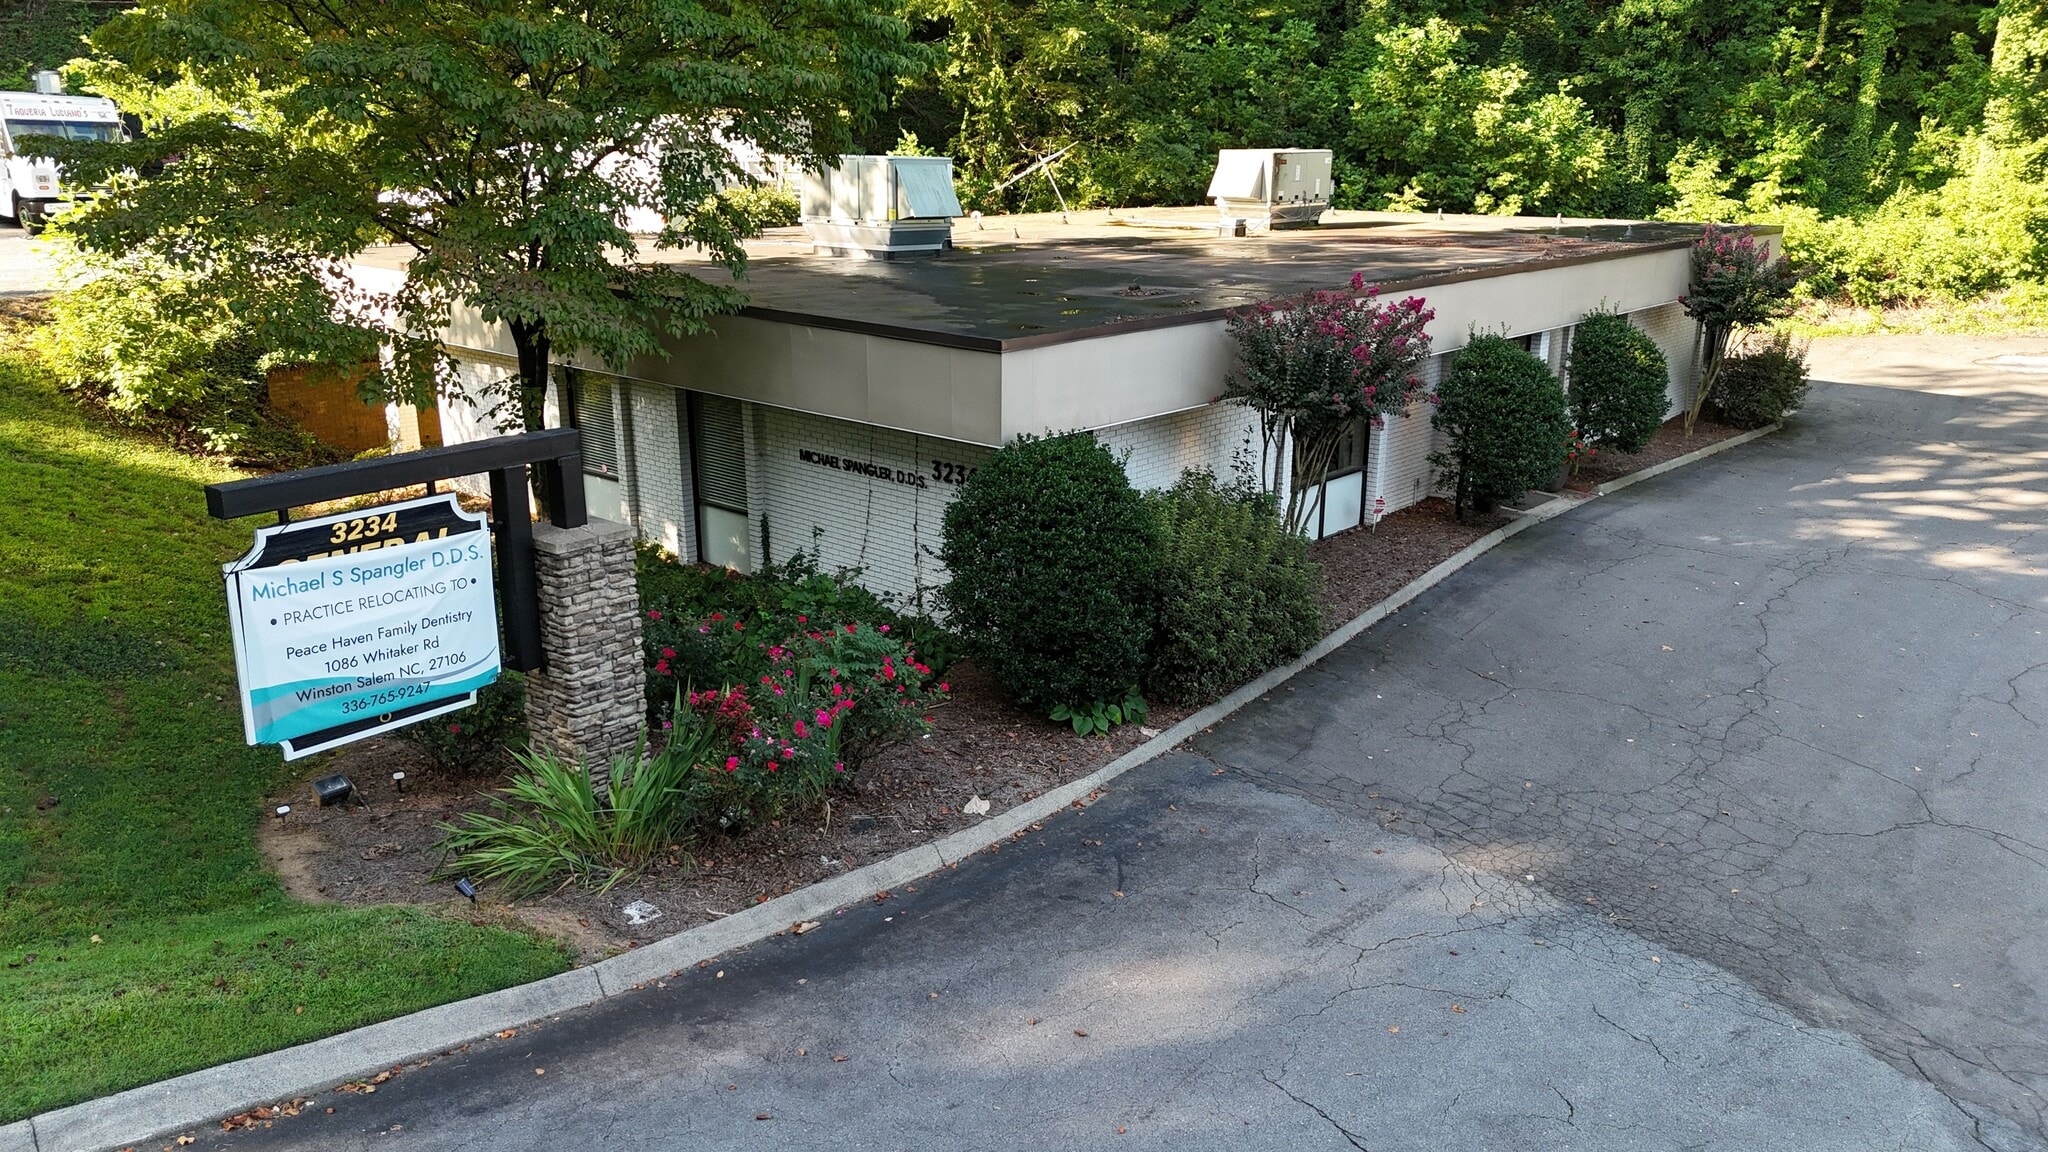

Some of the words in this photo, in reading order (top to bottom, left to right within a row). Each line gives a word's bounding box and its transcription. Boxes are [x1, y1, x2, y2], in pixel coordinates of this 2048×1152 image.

[800, 449, 841, 470] MICHAEL
[842, 458, 895, 483] SPANGLER,
[896, 470, 928, 489] D.D.S.
[330, 512, 398, 544] 3234
[252, 572, 325, 602] Michael
[332, 570, 344, 586] S
[350, 557, 426, 585] Spangler
[432, 545, 484, 568] D.D.S.
[283, 600, 354, 626] PRACTICE
[359, 580, 447, 610] RELOCATING
[450, 577, 468, 592] TO
[286, 642, 328, 660] Peace
[332, 632, 374, 651] Haven
[378, 619, 418, 642] Family
[421, 608, 473, 630] Dentistry
[324, 656, 359, 674] 1086
[362, 644, 419, 665] Whitaker
[423, 636, 440, 652] Rd
[295, 681, 352, 703] Winston
[356, 671, 396, 689] Salem
[399, 663, 424, 679] NC,
[429, 651, 467, 671] 27106
[341, 681, 431, 715] 336-765-9247
